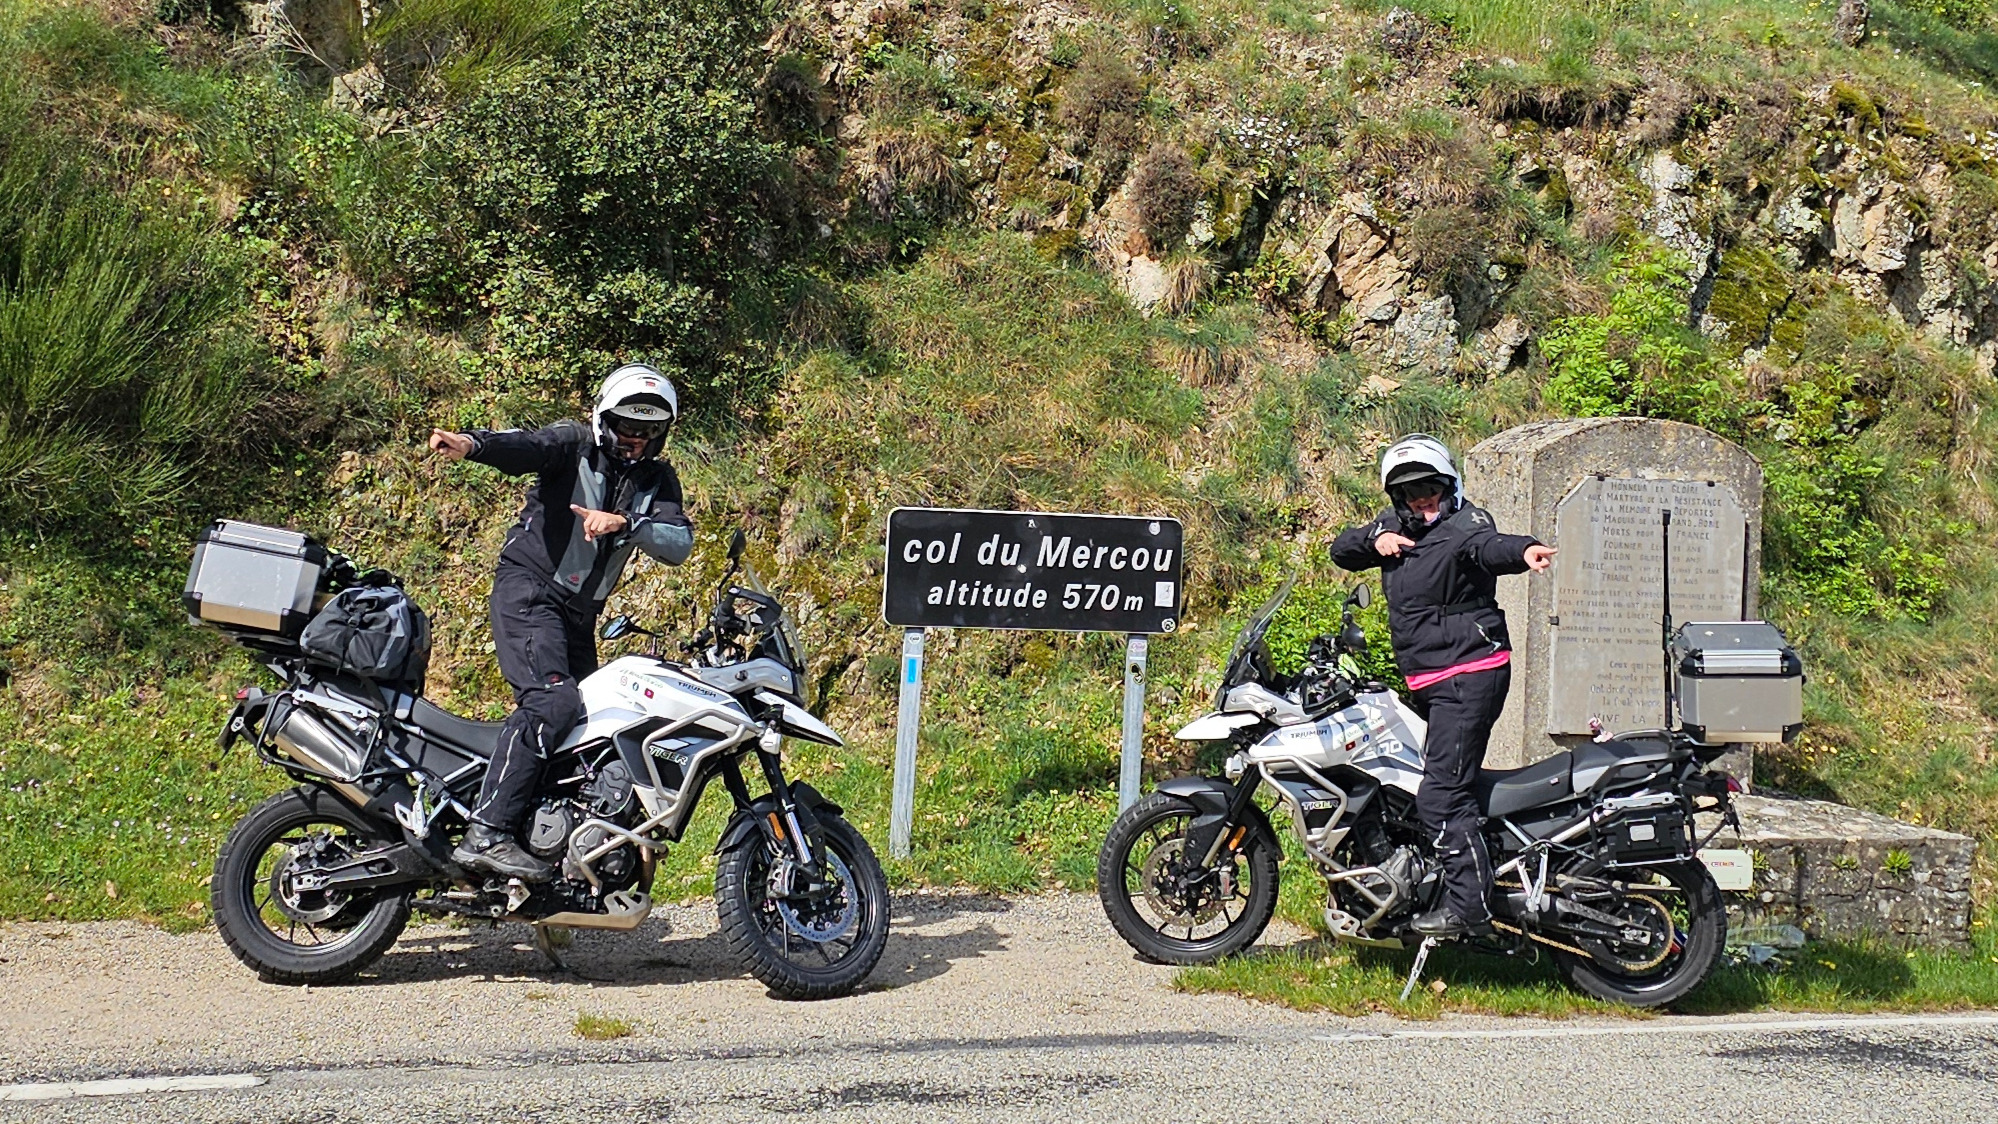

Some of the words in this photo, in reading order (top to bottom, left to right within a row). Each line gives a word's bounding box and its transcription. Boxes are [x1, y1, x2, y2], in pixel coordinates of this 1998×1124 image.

[633, 407, 653, 416] SHOEI
[903, 532, 962, 564] col
[977, 534, 1021, 567] du
[1036, 536, 1173, 572] Mercou
[927, 579, 1048, 609] altitude
[1062, 583, 1120, 611] 570
[678, 681, 717, 698] TRIUMPH
[1631, 714, 1646, 724] LA
[1290, 729, 1328, 739] TRIUMPH
[648, 745, 689, 766] TIGER
[1301, 799, 1340, 811] TIGER
